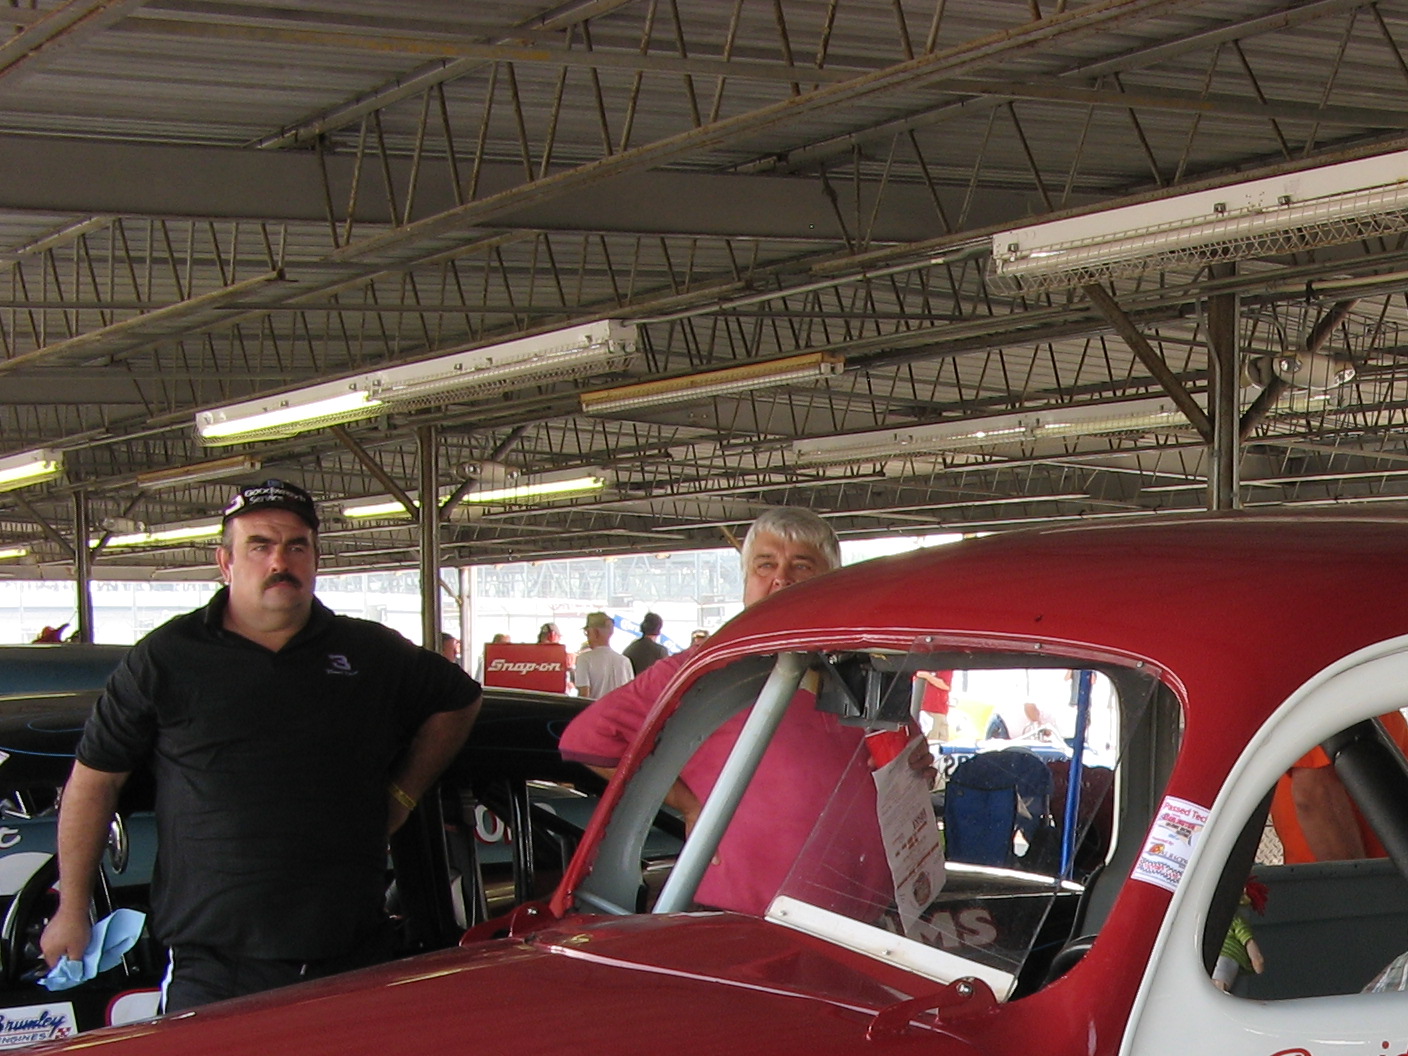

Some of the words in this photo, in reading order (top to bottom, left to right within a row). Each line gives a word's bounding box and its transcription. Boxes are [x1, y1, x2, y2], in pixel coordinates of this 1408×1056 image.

[487, 658, 562, 676] Snap-on
[1162, 802, 1191, 816] Passed
[0, 1032, 47, 1044] NGINES
